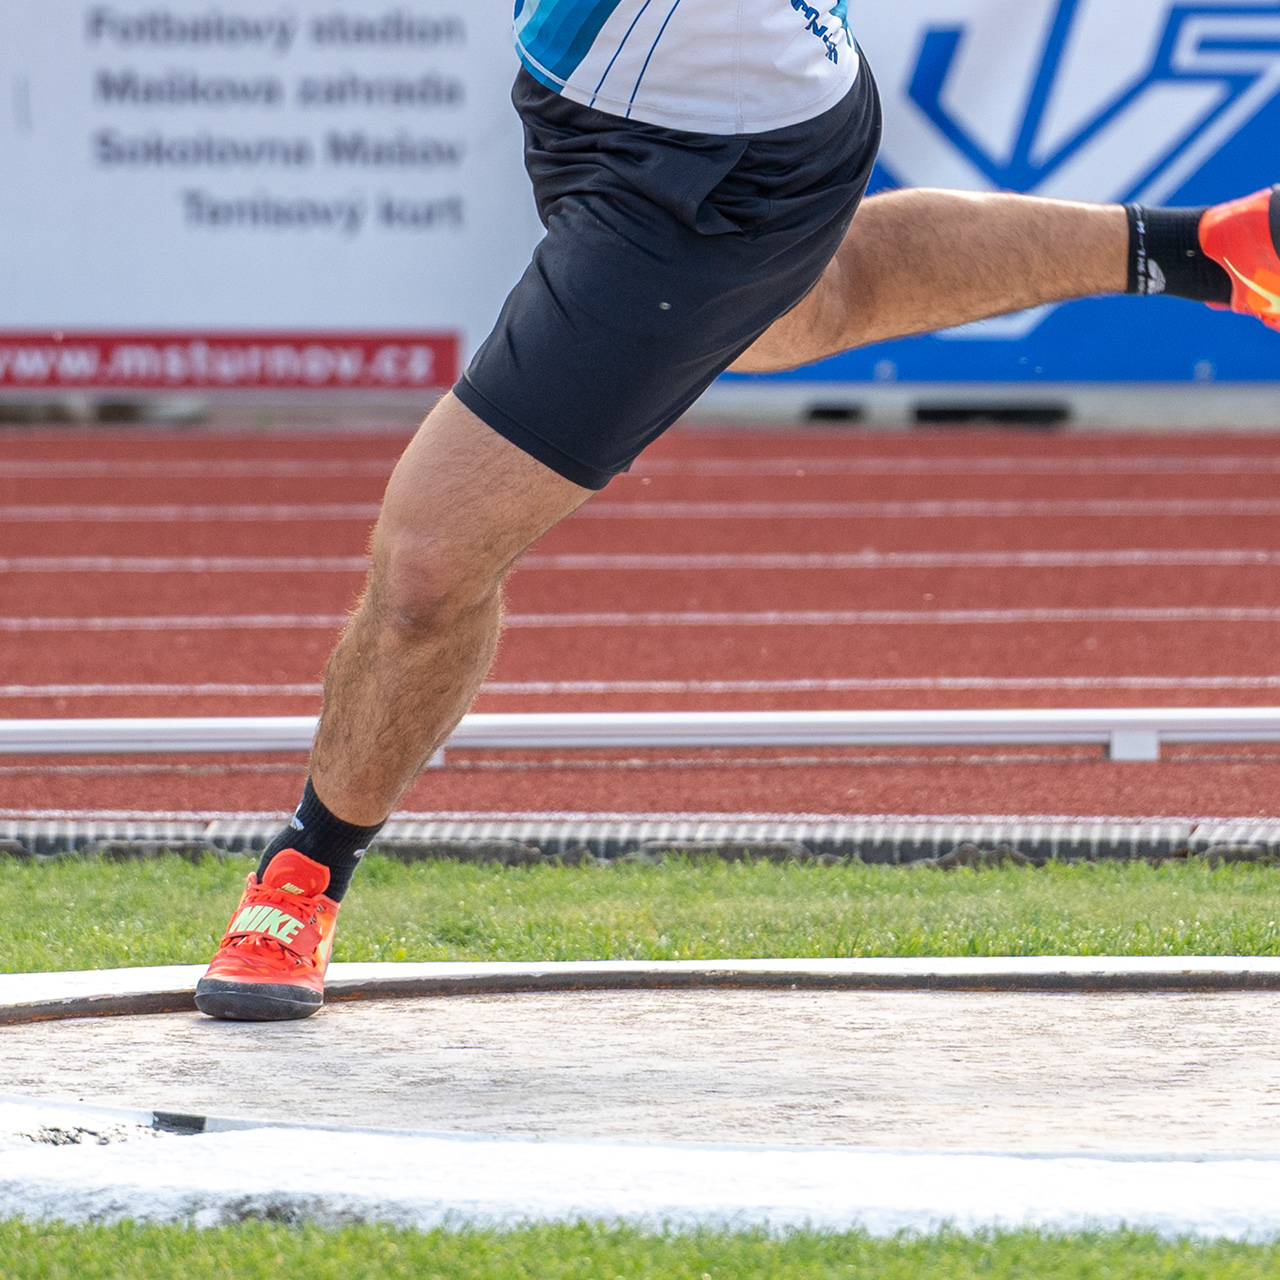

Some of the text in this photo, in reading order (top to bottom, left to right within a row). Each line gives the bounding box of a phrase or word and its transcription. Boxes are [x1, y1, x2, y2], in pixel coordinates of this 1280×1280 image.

[86, 6, 466, 55] Fotbalový stadion
[297, 69, 464, 107] zahrada
[93, 128, 314, 167] Sokolovna
[183, 188, 464, 237] Tenisový kurt
[228, 905, 305, 945] NIKE
